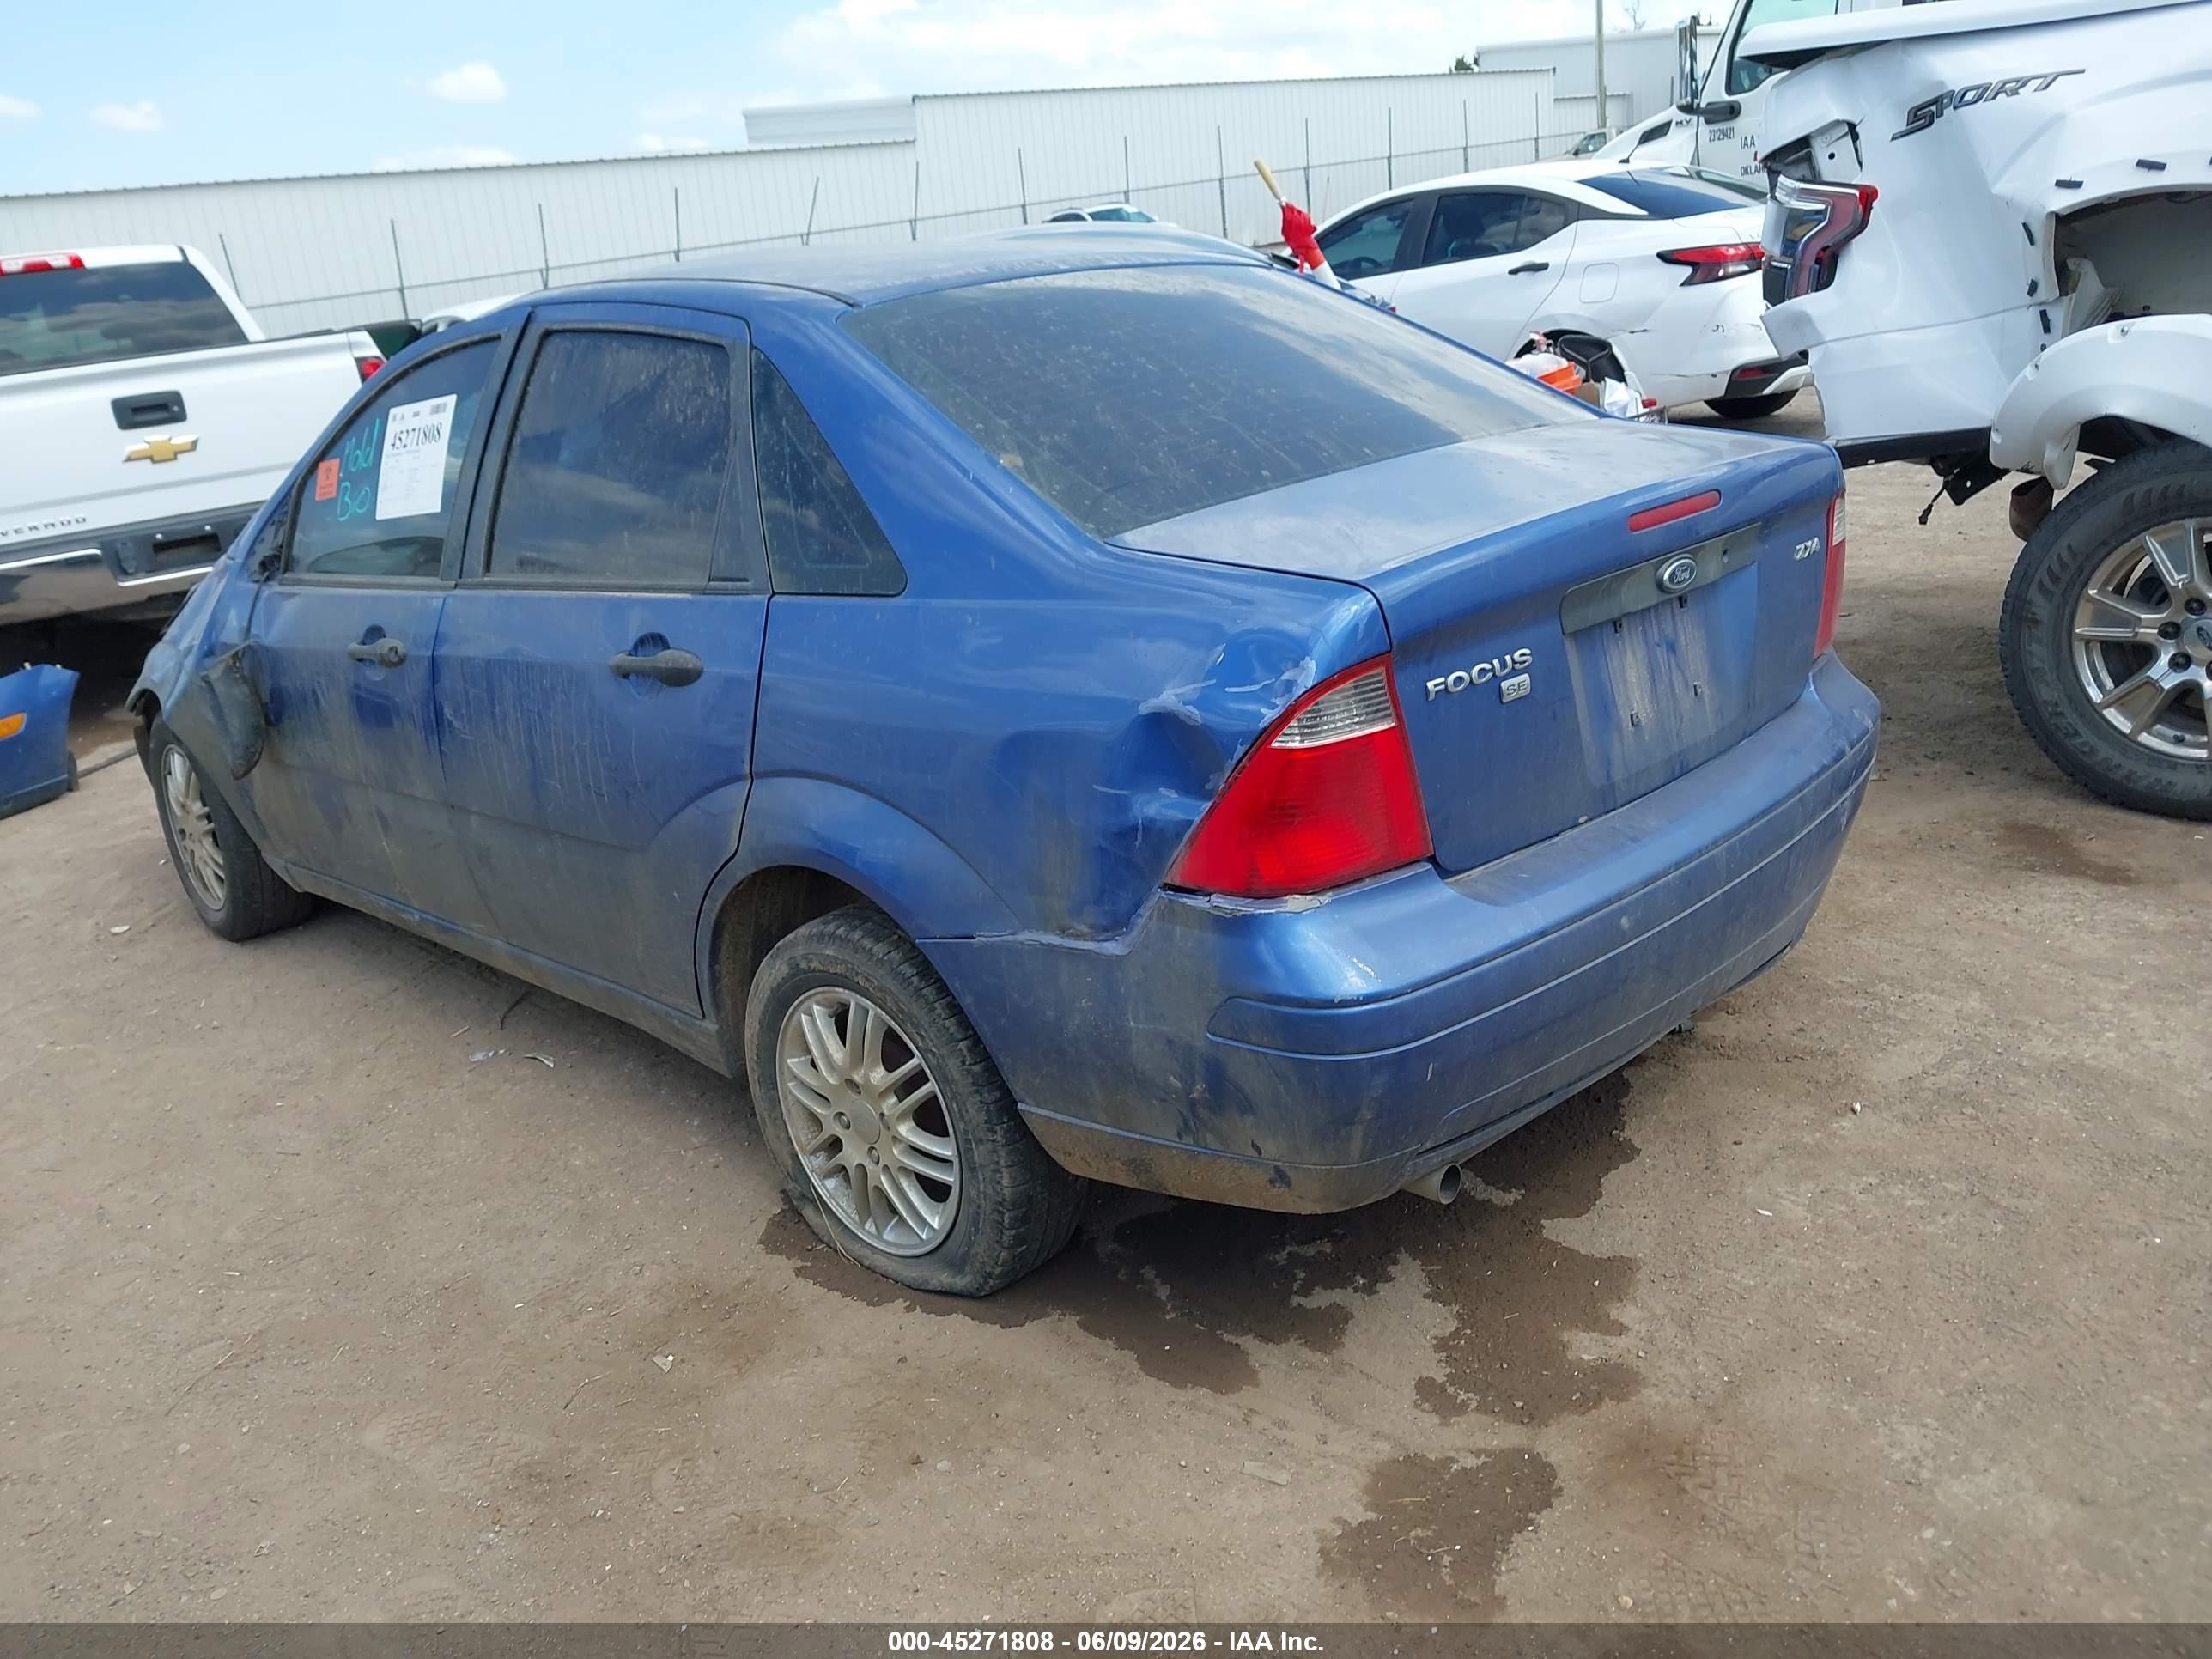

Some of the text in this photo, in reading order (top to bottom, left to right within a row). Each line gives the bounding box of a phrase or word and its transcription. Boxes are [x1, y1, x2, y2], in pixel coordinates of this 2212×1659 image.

[1890, 68, 2087, 143] SPORT
[1709, 126, 1735, 143] 23129421
[1740, 135, 1755, 149] IAA
[1740, 163, 1767, 176] OKLAH
[391, 422, 443, 451] 45271808
[1425, 647, 1533, 702] FOCUS
[1506, 679, 1528, 696] SE
